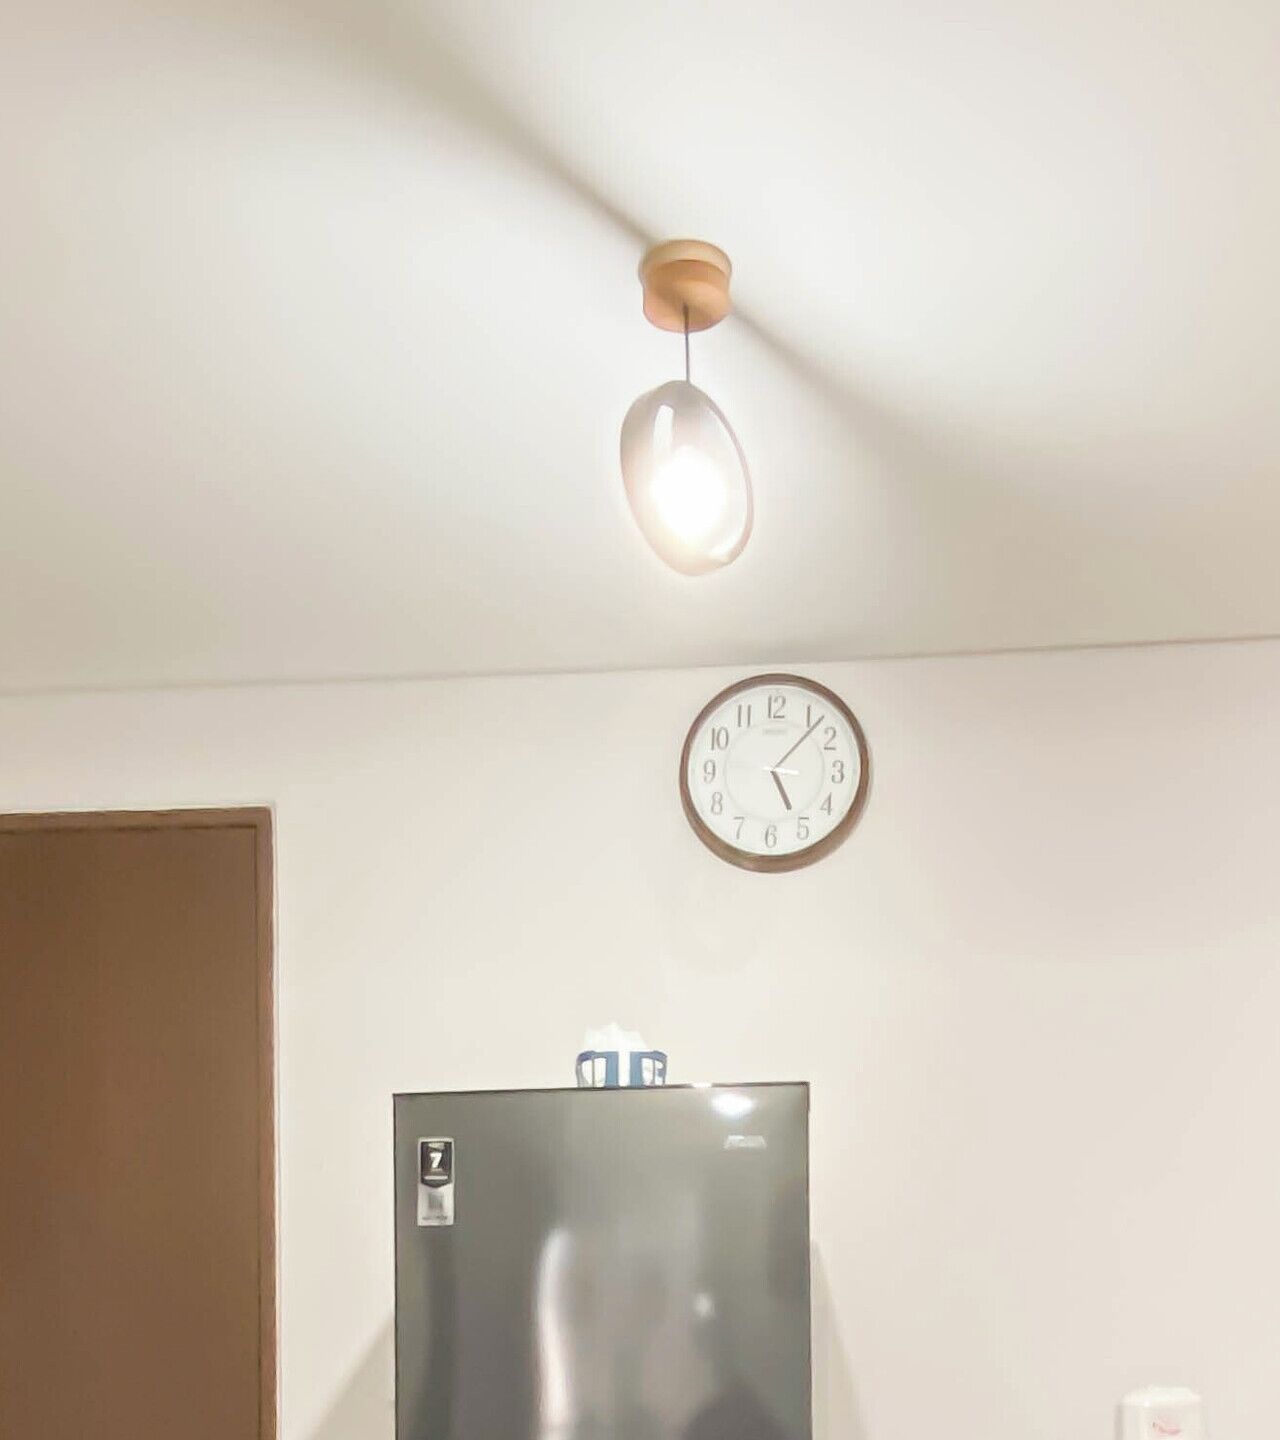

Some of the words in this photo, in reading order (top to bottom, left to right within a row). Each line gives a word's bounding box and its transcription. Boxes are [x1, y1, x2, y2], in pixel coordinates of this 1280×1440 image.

[737, 704, 751, 728] 11
[768, 694, 786, 719] 12
[711, 727, 729, 751] 10
[823, 726, 837, 751] 2
[703, 760, 716, 783] 9
[831, 760, 845, 784] 3
[710, 791, 723, 815] 8
[820, 792, 833, 816] 4
[733, 816, 745, 839] 7
[765, 824, 777, 848] 6
[796, 816, 810, 840] 5
[429, 1152, 443, 1168] 7
